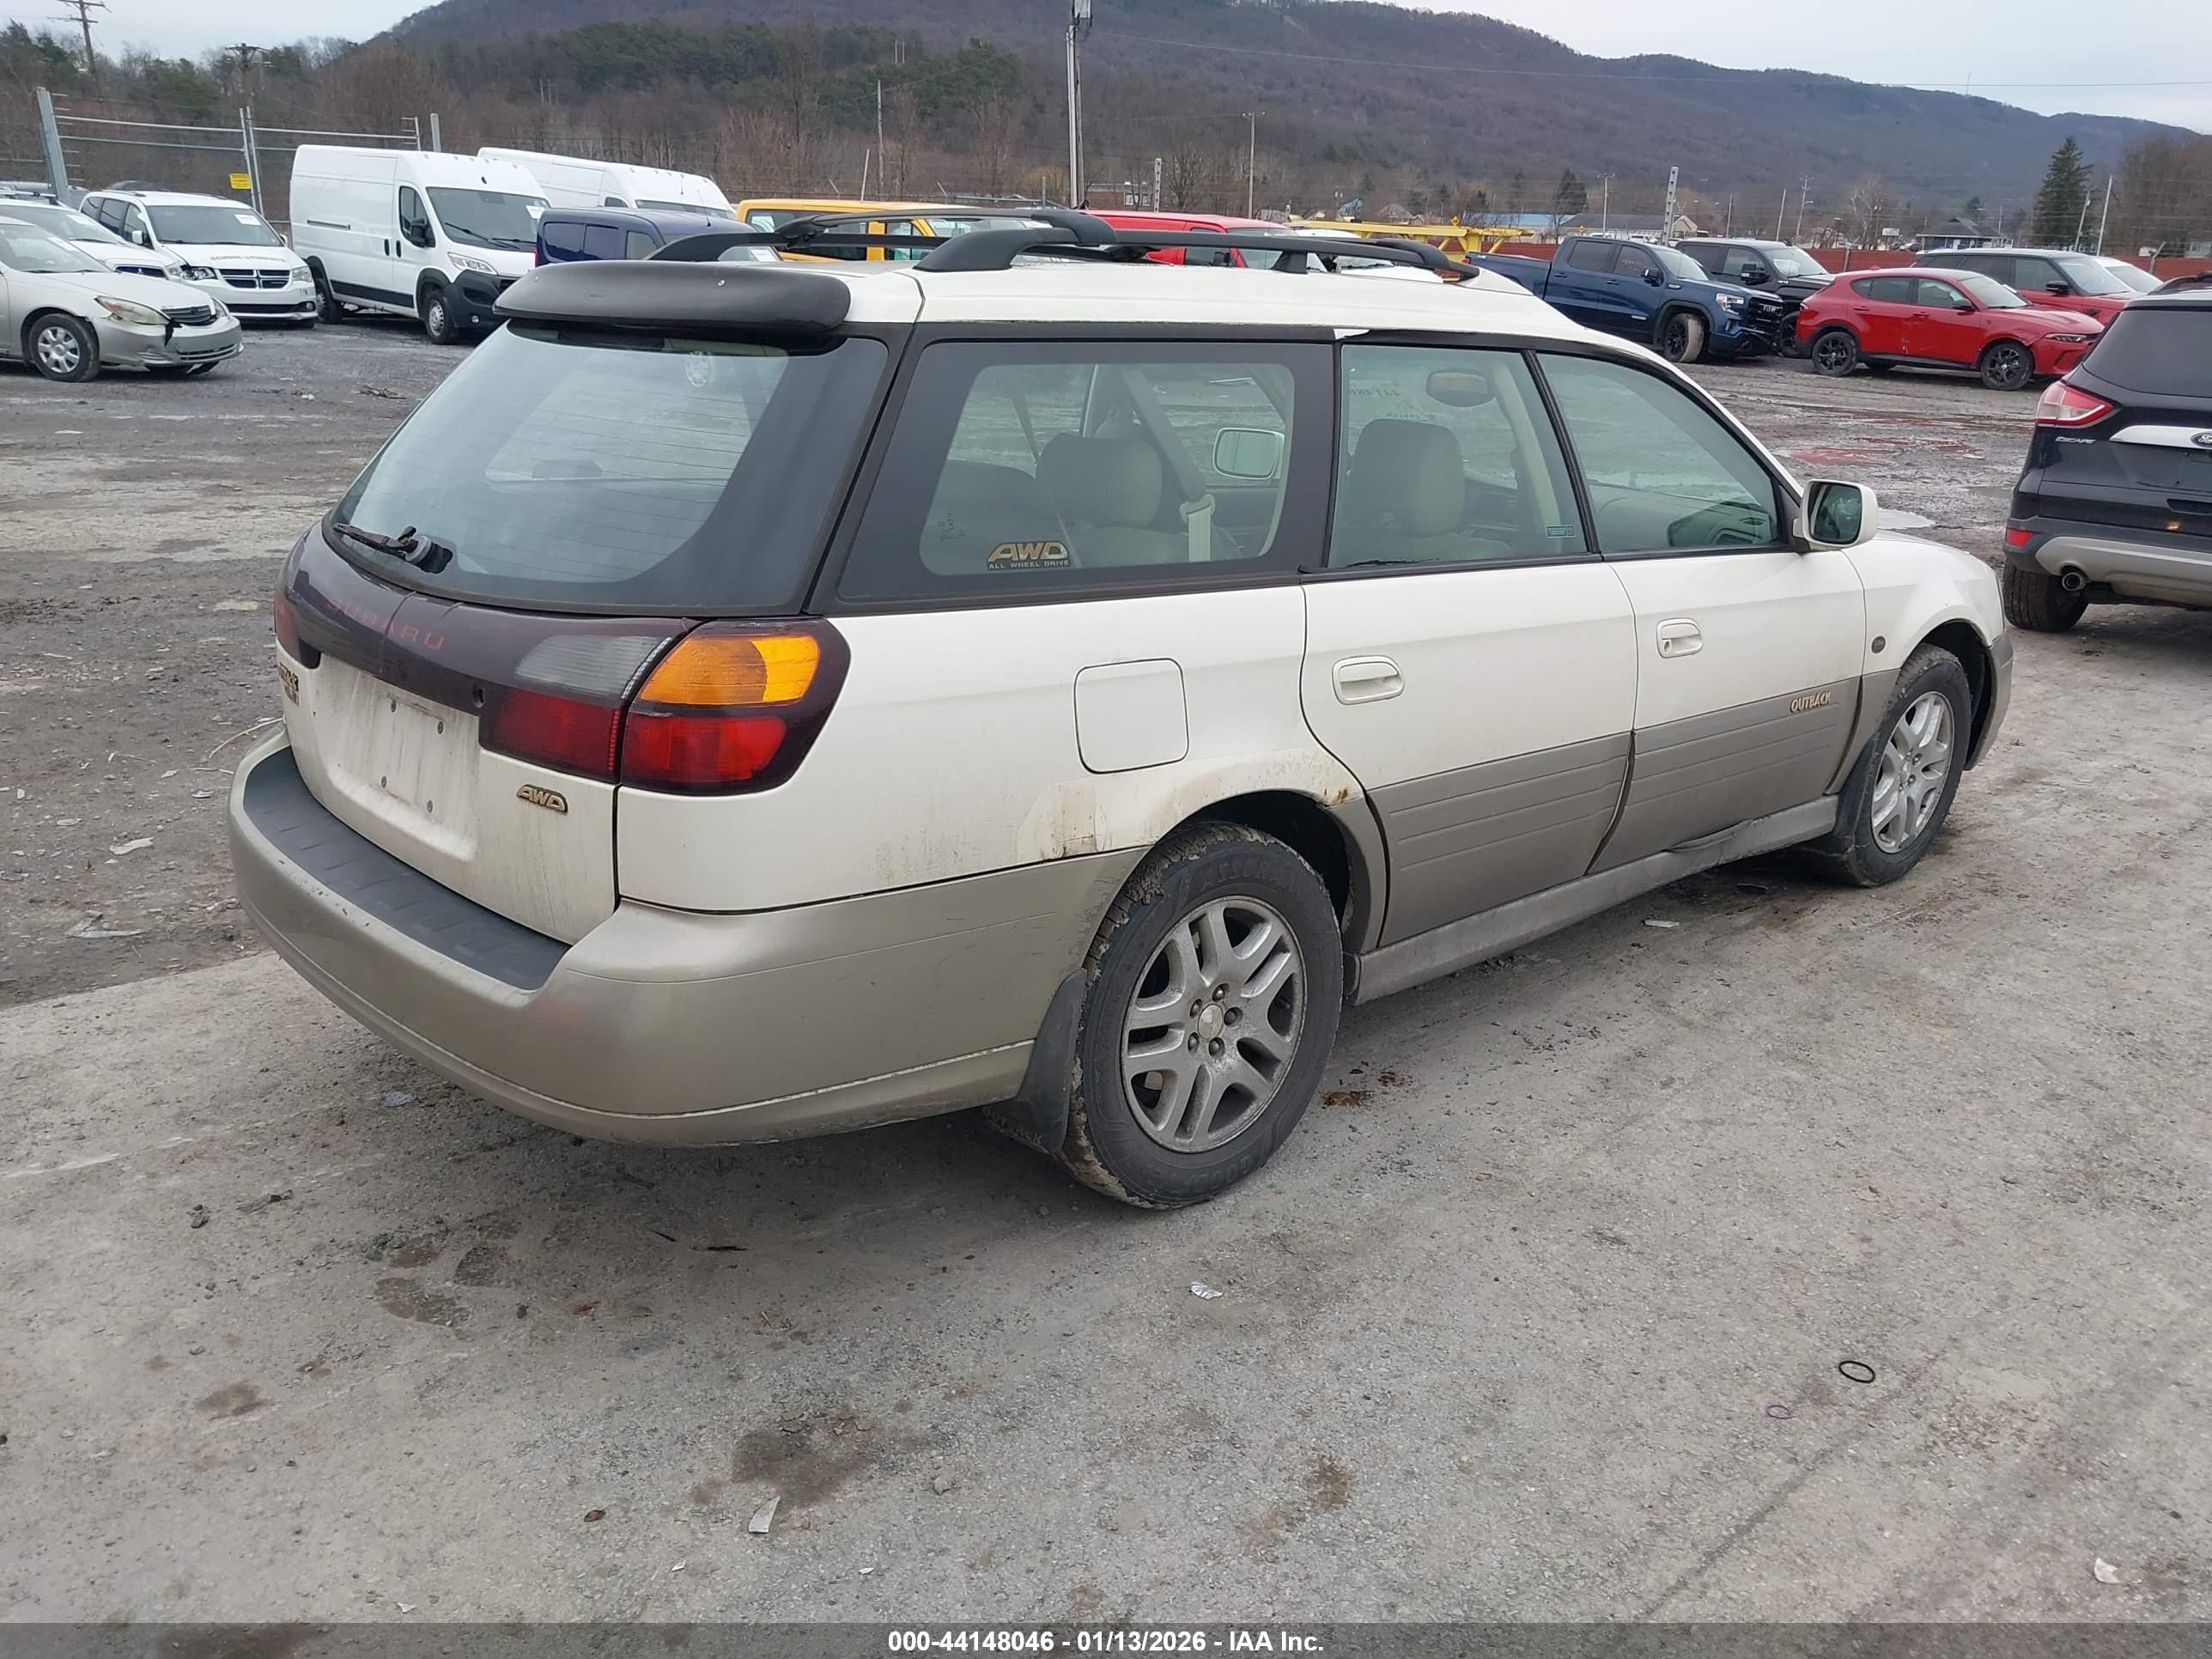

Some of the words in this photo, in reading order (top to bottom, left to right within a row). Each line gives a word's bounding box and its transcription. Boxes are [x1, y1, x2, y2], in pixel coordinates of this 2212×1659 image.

[987, 541, 1069, 562] AWD
[1043, 559, 1069, 568] DRIVE
[328, 599, 445, 650] SUBARU
[1790, 690, 1832, 713] OUTBACK
[516, 785, 567, 812] AWD
